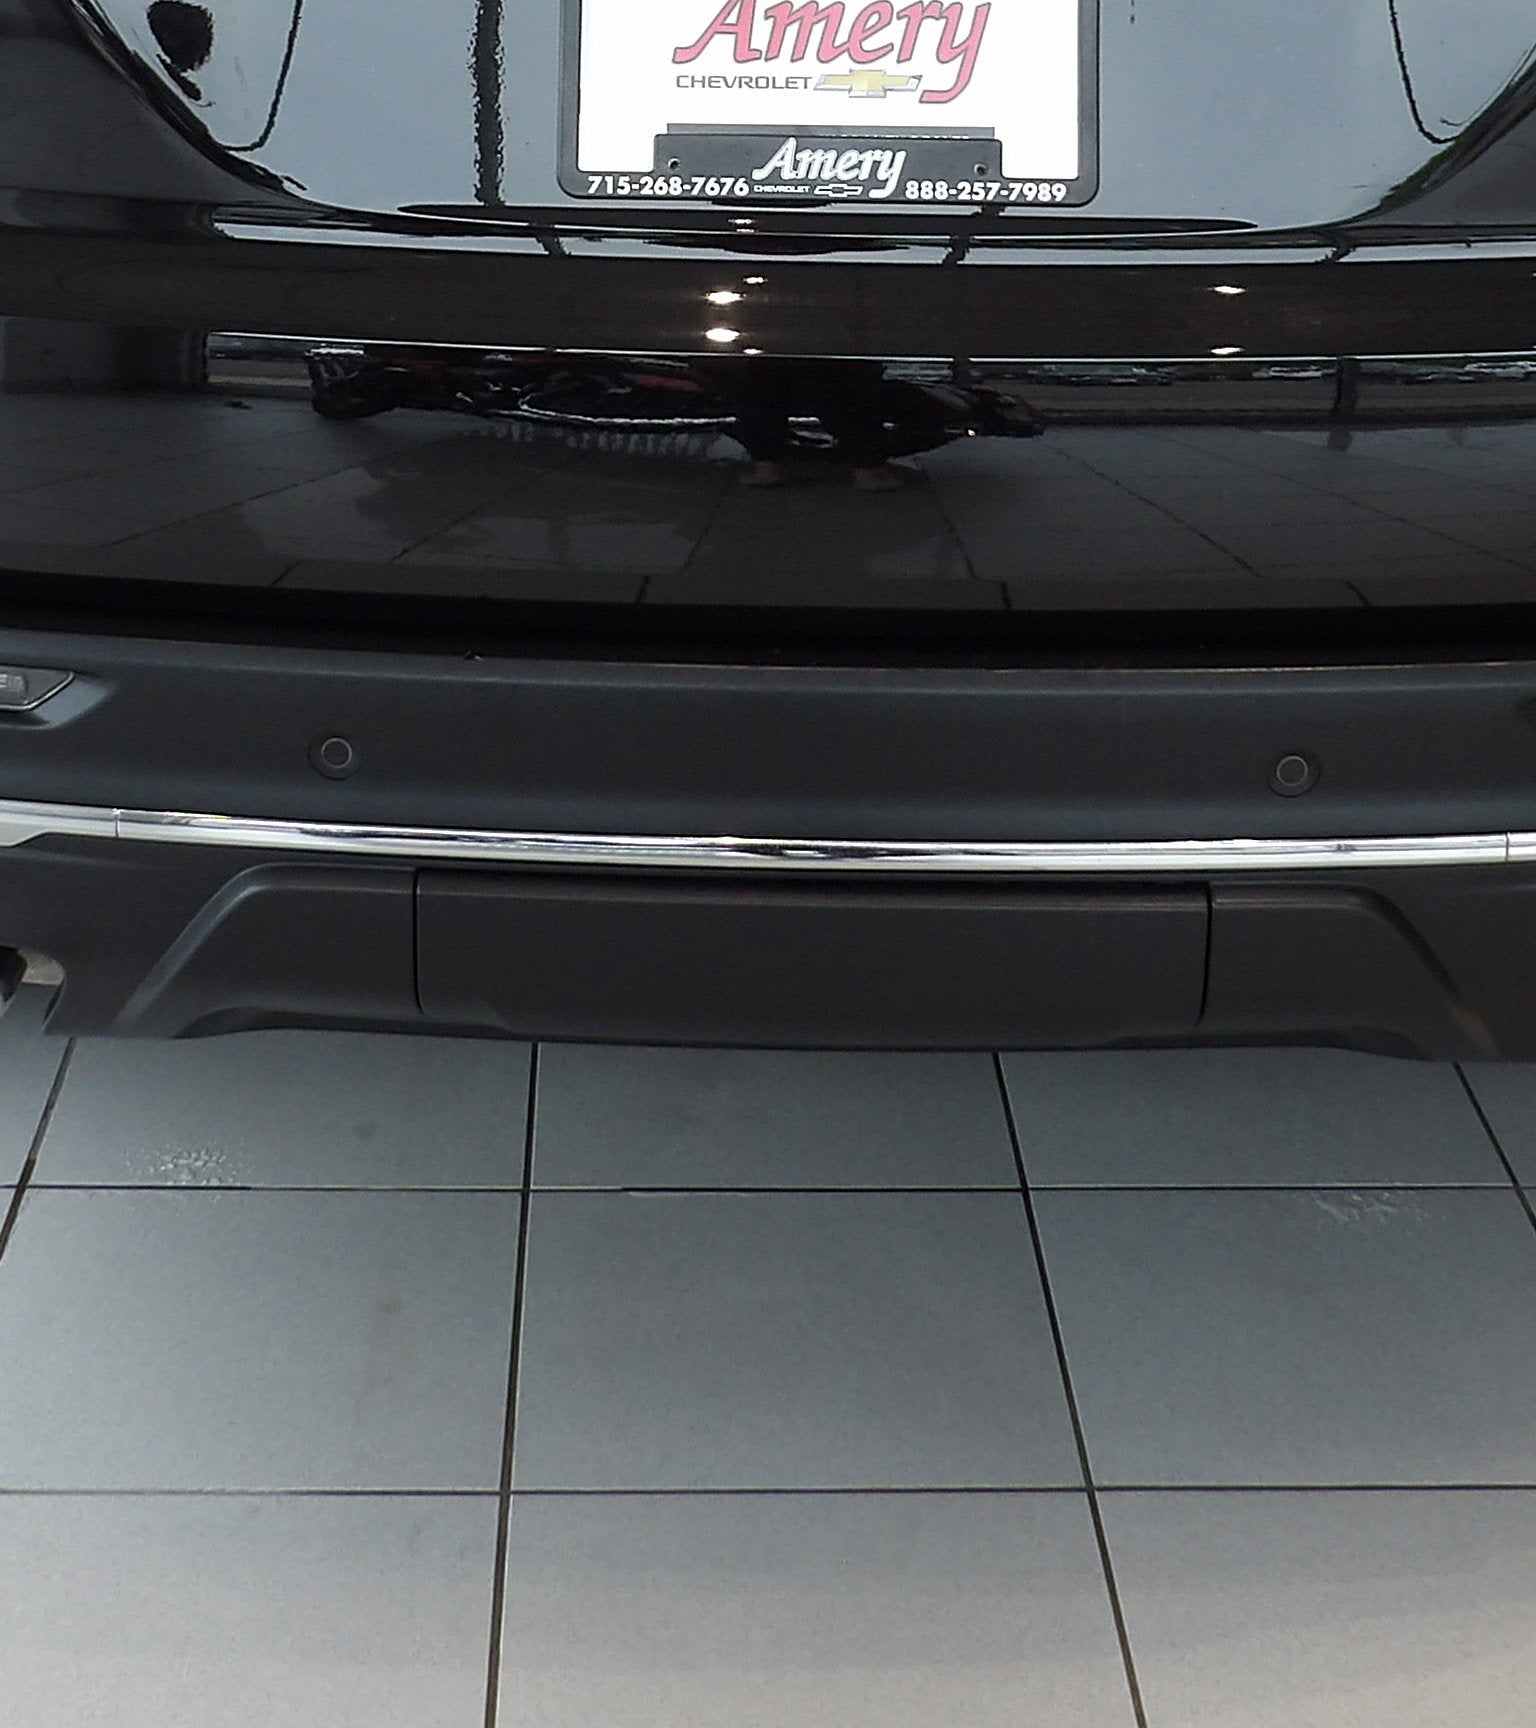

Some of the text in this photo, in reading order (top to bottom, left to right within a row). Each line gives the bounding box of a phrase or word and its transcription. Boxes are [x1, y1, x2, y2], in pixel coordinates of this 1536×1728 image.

[675, 74, 814, 91] CHEVROLET
[751, 137, 907, 199] Amery
[586, 175, 750, 198] 715-268-7676
[905, 180, 1067, 204] 888-257-7989
